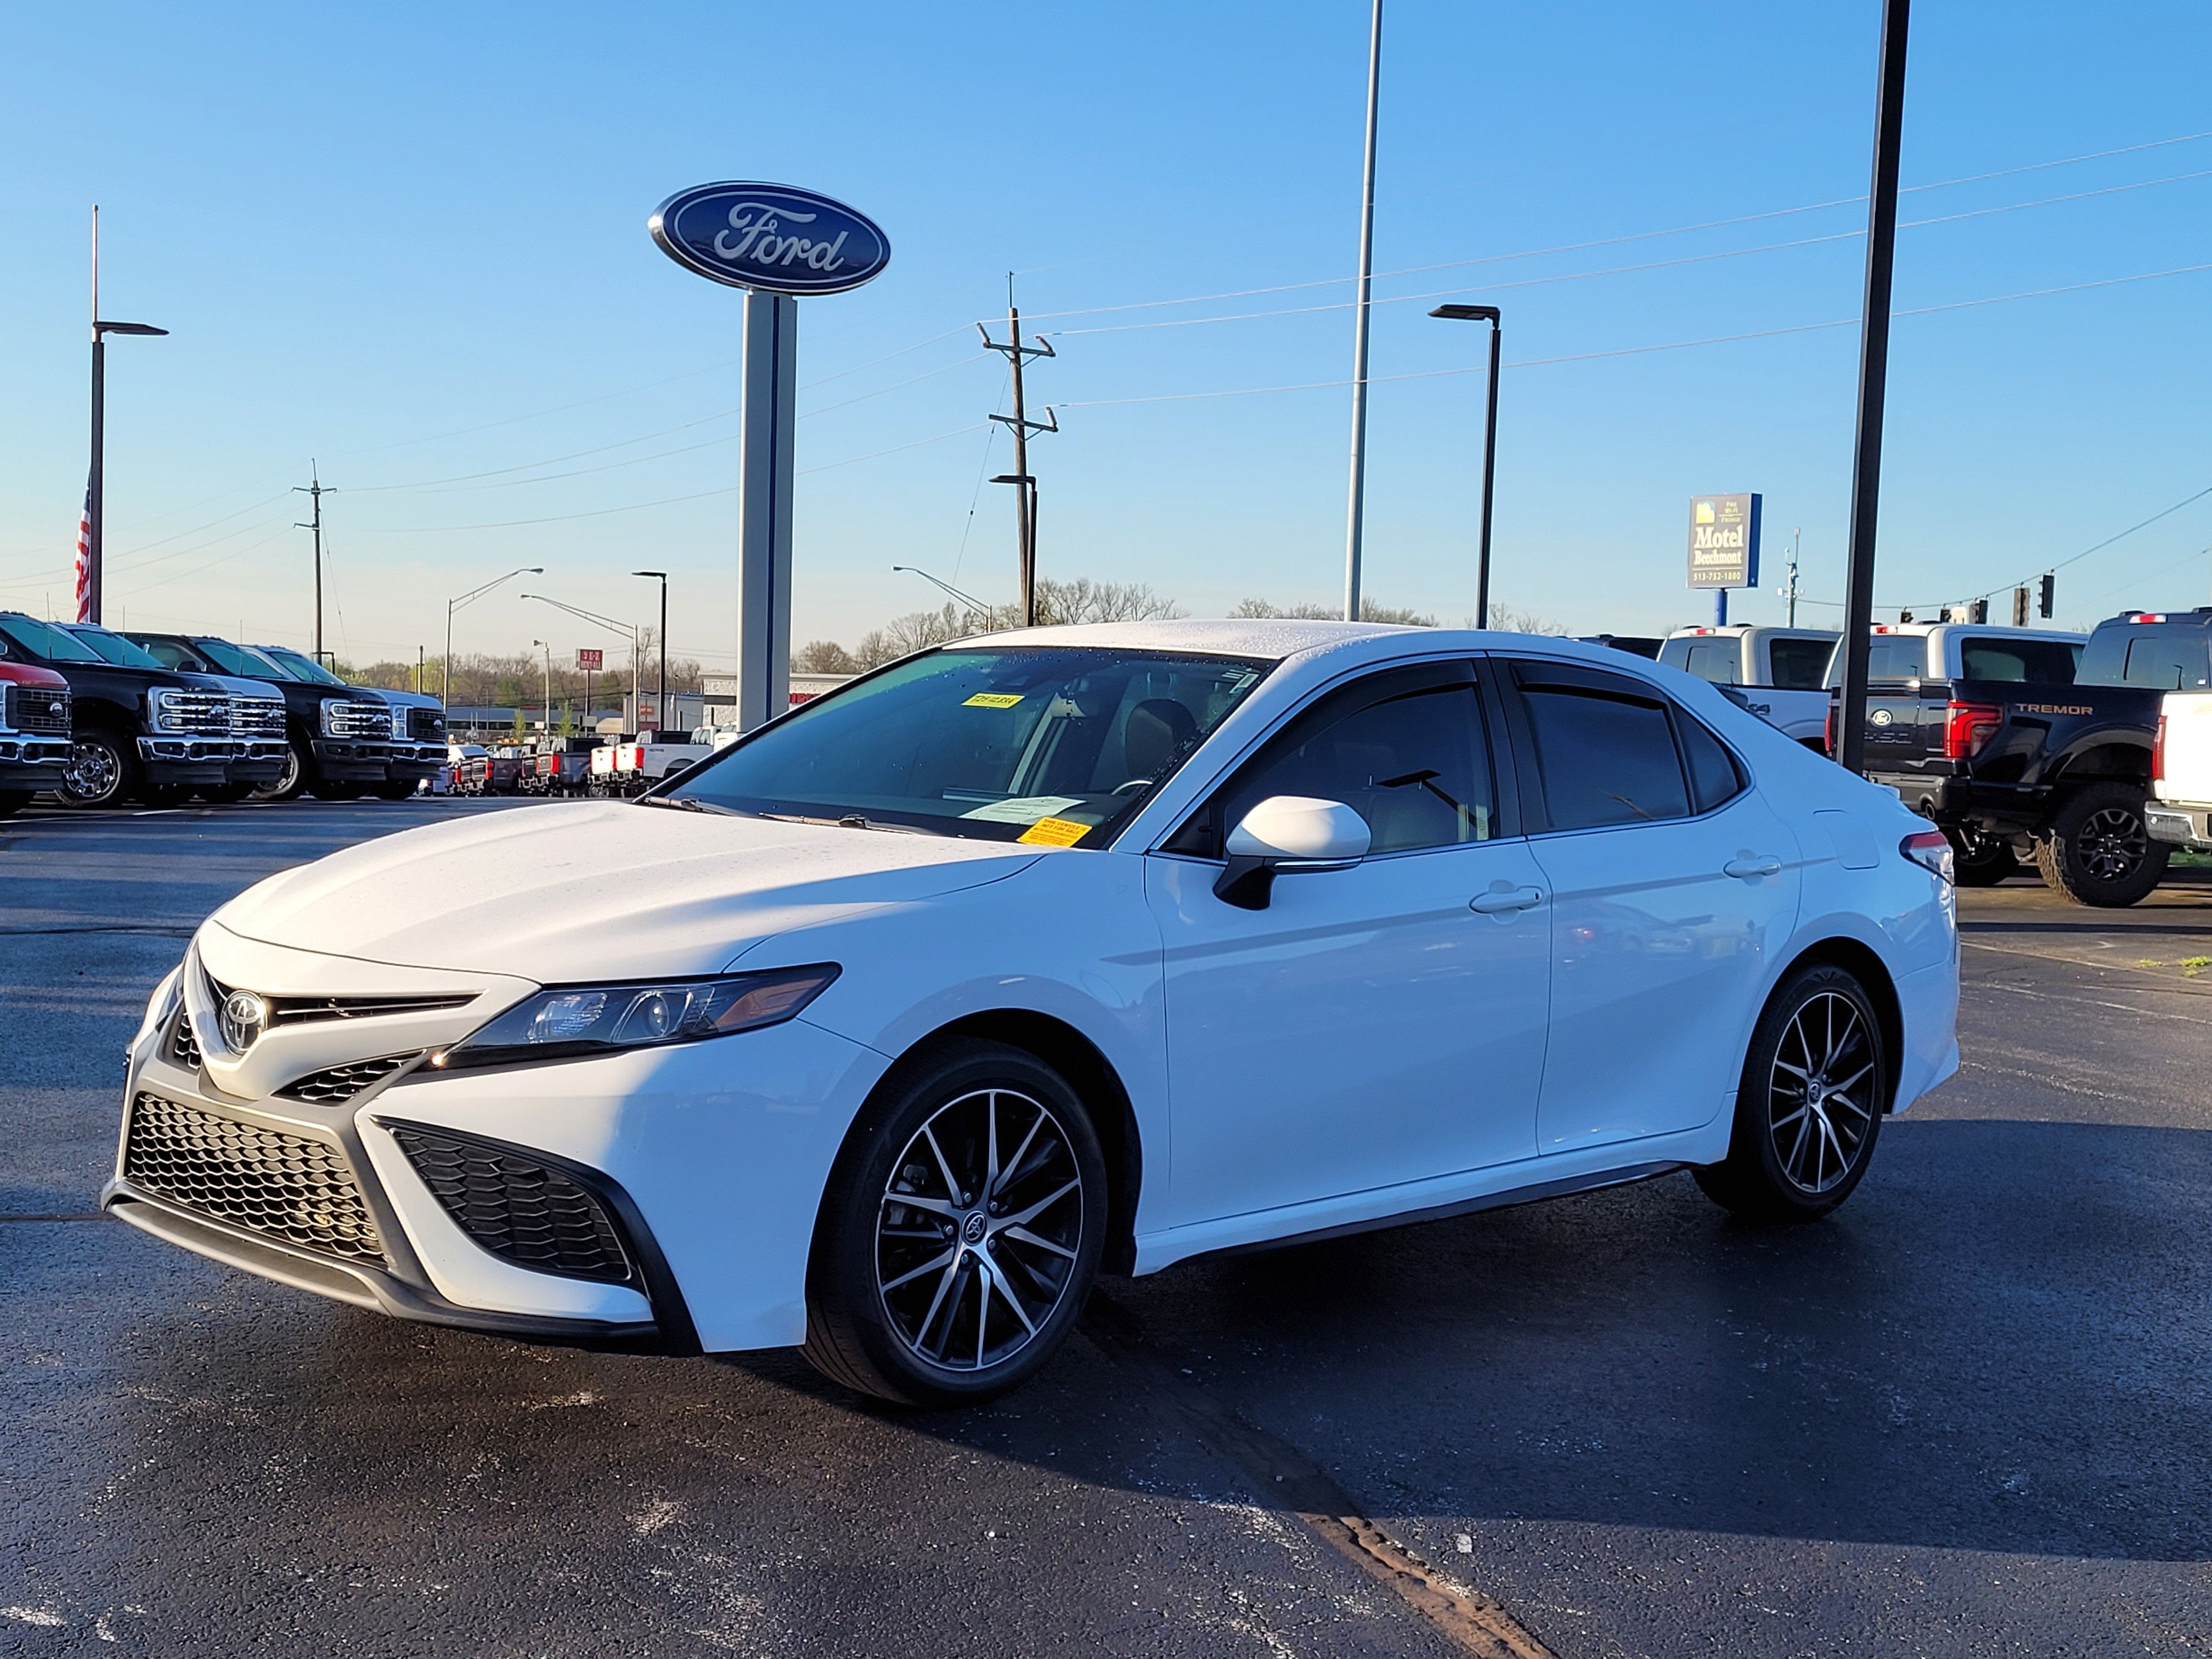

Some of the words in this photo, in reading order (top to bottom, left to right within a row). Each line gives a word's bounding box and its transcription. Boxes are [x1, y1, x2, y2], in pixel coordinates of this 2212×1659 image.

[713, 202, 849, 272] Ford
[1694, 524, 1743, 549] Motel
[1693, 549, 1742, 565] Beechmont
[2016, 703, 2093, 715] TREMOR
